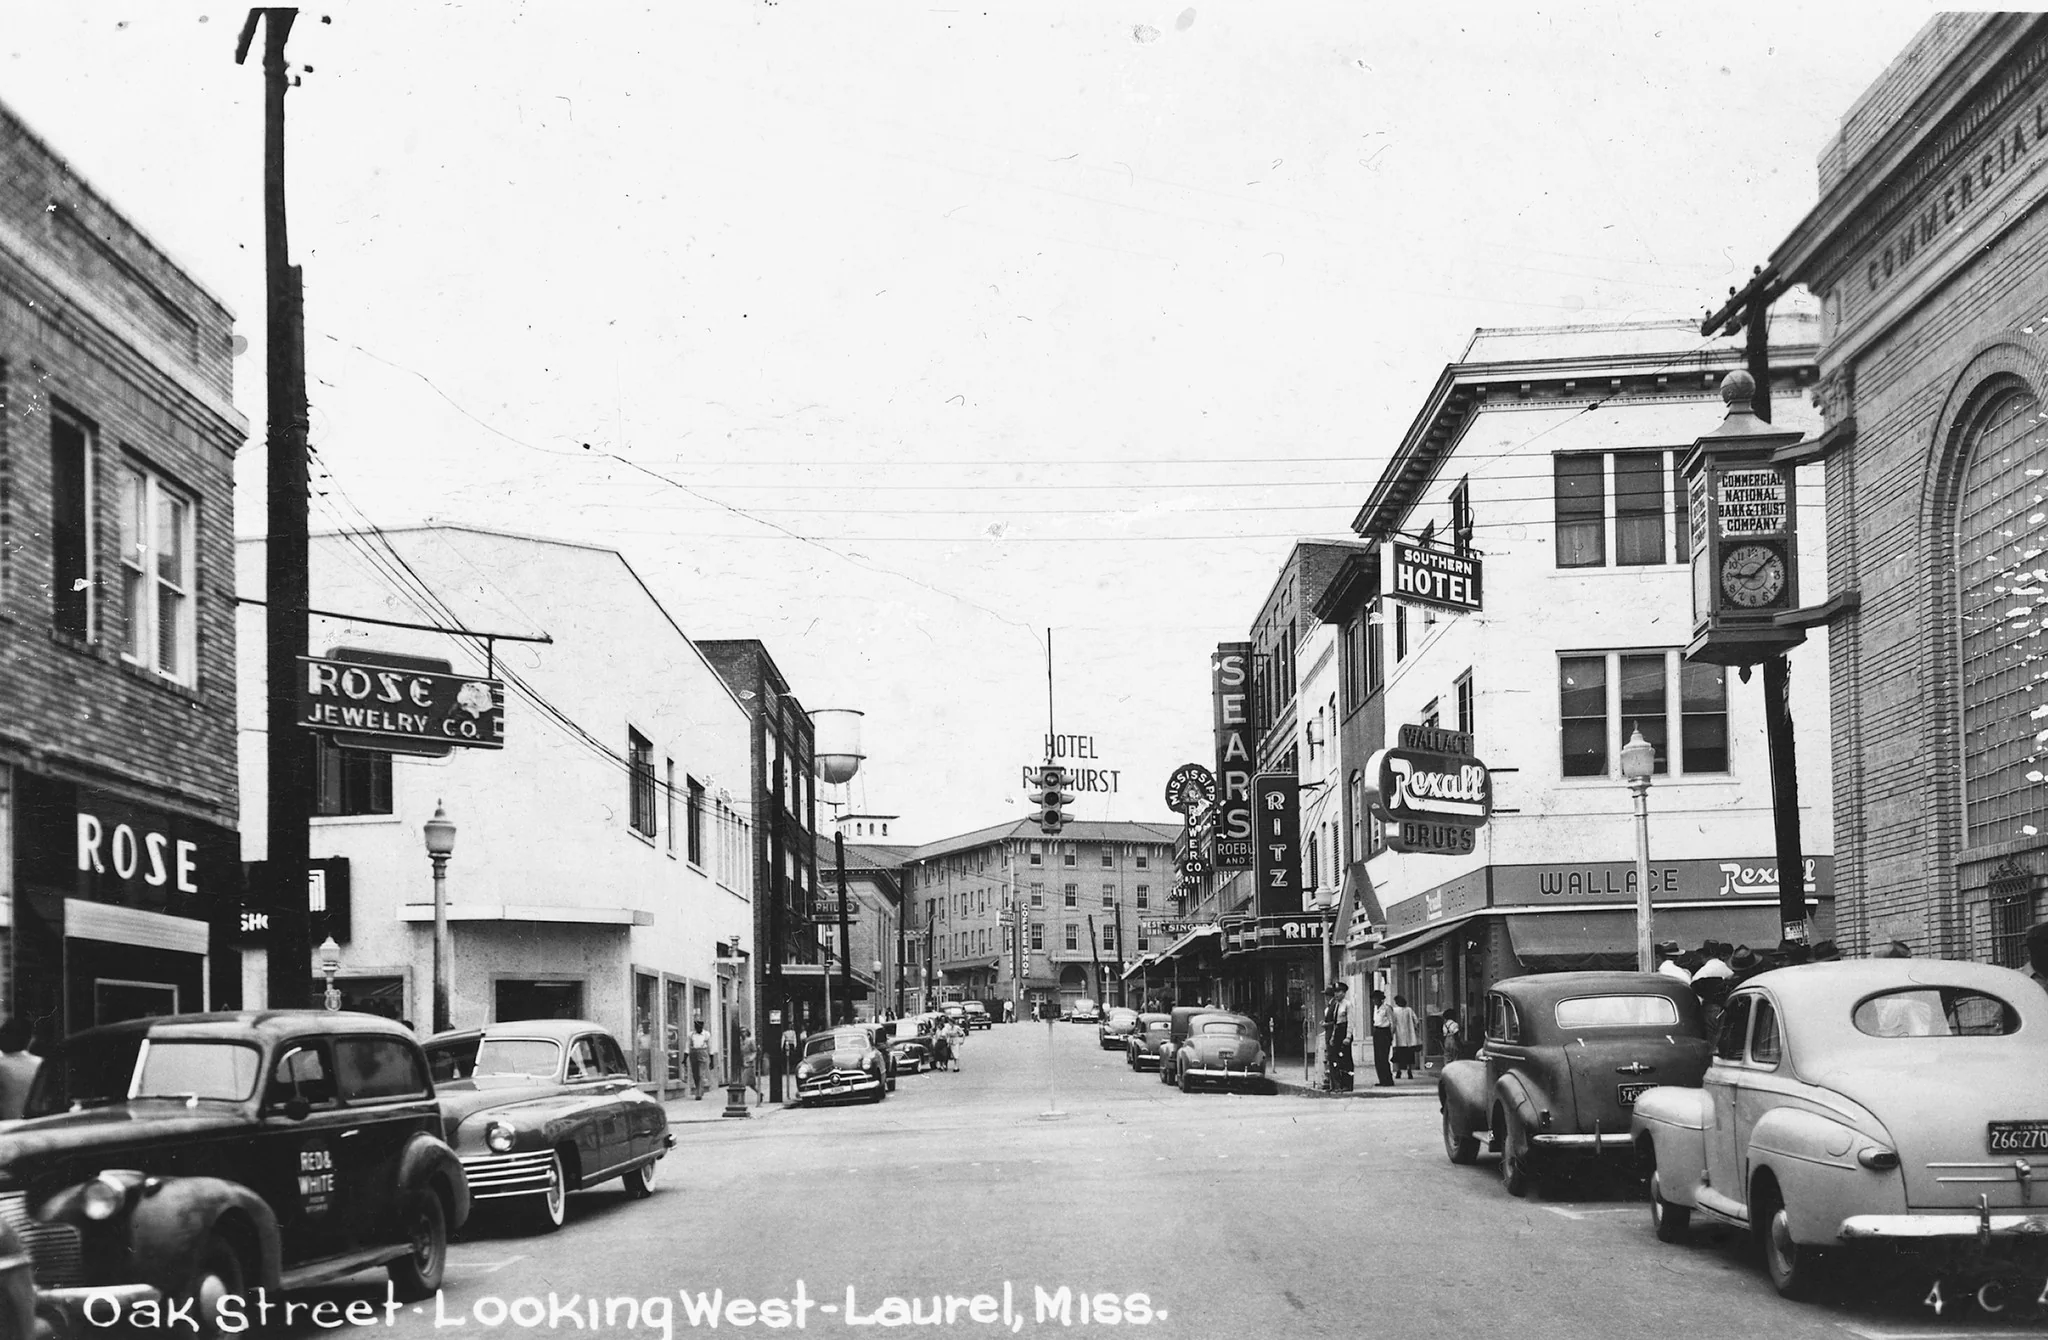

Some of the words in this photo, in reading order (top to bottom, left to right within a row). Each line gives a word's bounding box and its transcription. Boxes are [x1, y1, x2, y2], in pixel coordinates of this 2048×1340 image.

[1868, 103, 2048, 291] COMMERCIAL
[1722, 474, 1783, 487] COMMERCIAL
[1725, 489, 1778, 502] NATIONAL
[1727, 518, 1779, 531] COMPANY
[1404, 549, 1472, 575] SOUTHERN
[1398, 563, 1479, 606] HOTEL
[308, 662, 433, 707] ROSE
[308, 703, 429, 733] JEWELRY
[442, 719, 480, 739] CO.
[1044, 733, 1099, 759] HOTEL
[1220, 655, 1250, 839] SEARS
[1402, 727, 1472, 755] WALLACE
[1389, 756, 1486, 817] Rexall
[1188, 805, 1199, 861] POWER
[1265, 791, 1288, 887] RITZ
[1403, 823, 1472, 851] DRUGS
[77, 813, 198, 894] ROSE
[1226, 857, 1246, 865] AND
[815, 903, 855, 912] PHILO
[1281, 921, 1334, 939] RITZ
[1991, 1131, 2018, 1149] 266
[298, 1173, 334, 1195] WHITE
